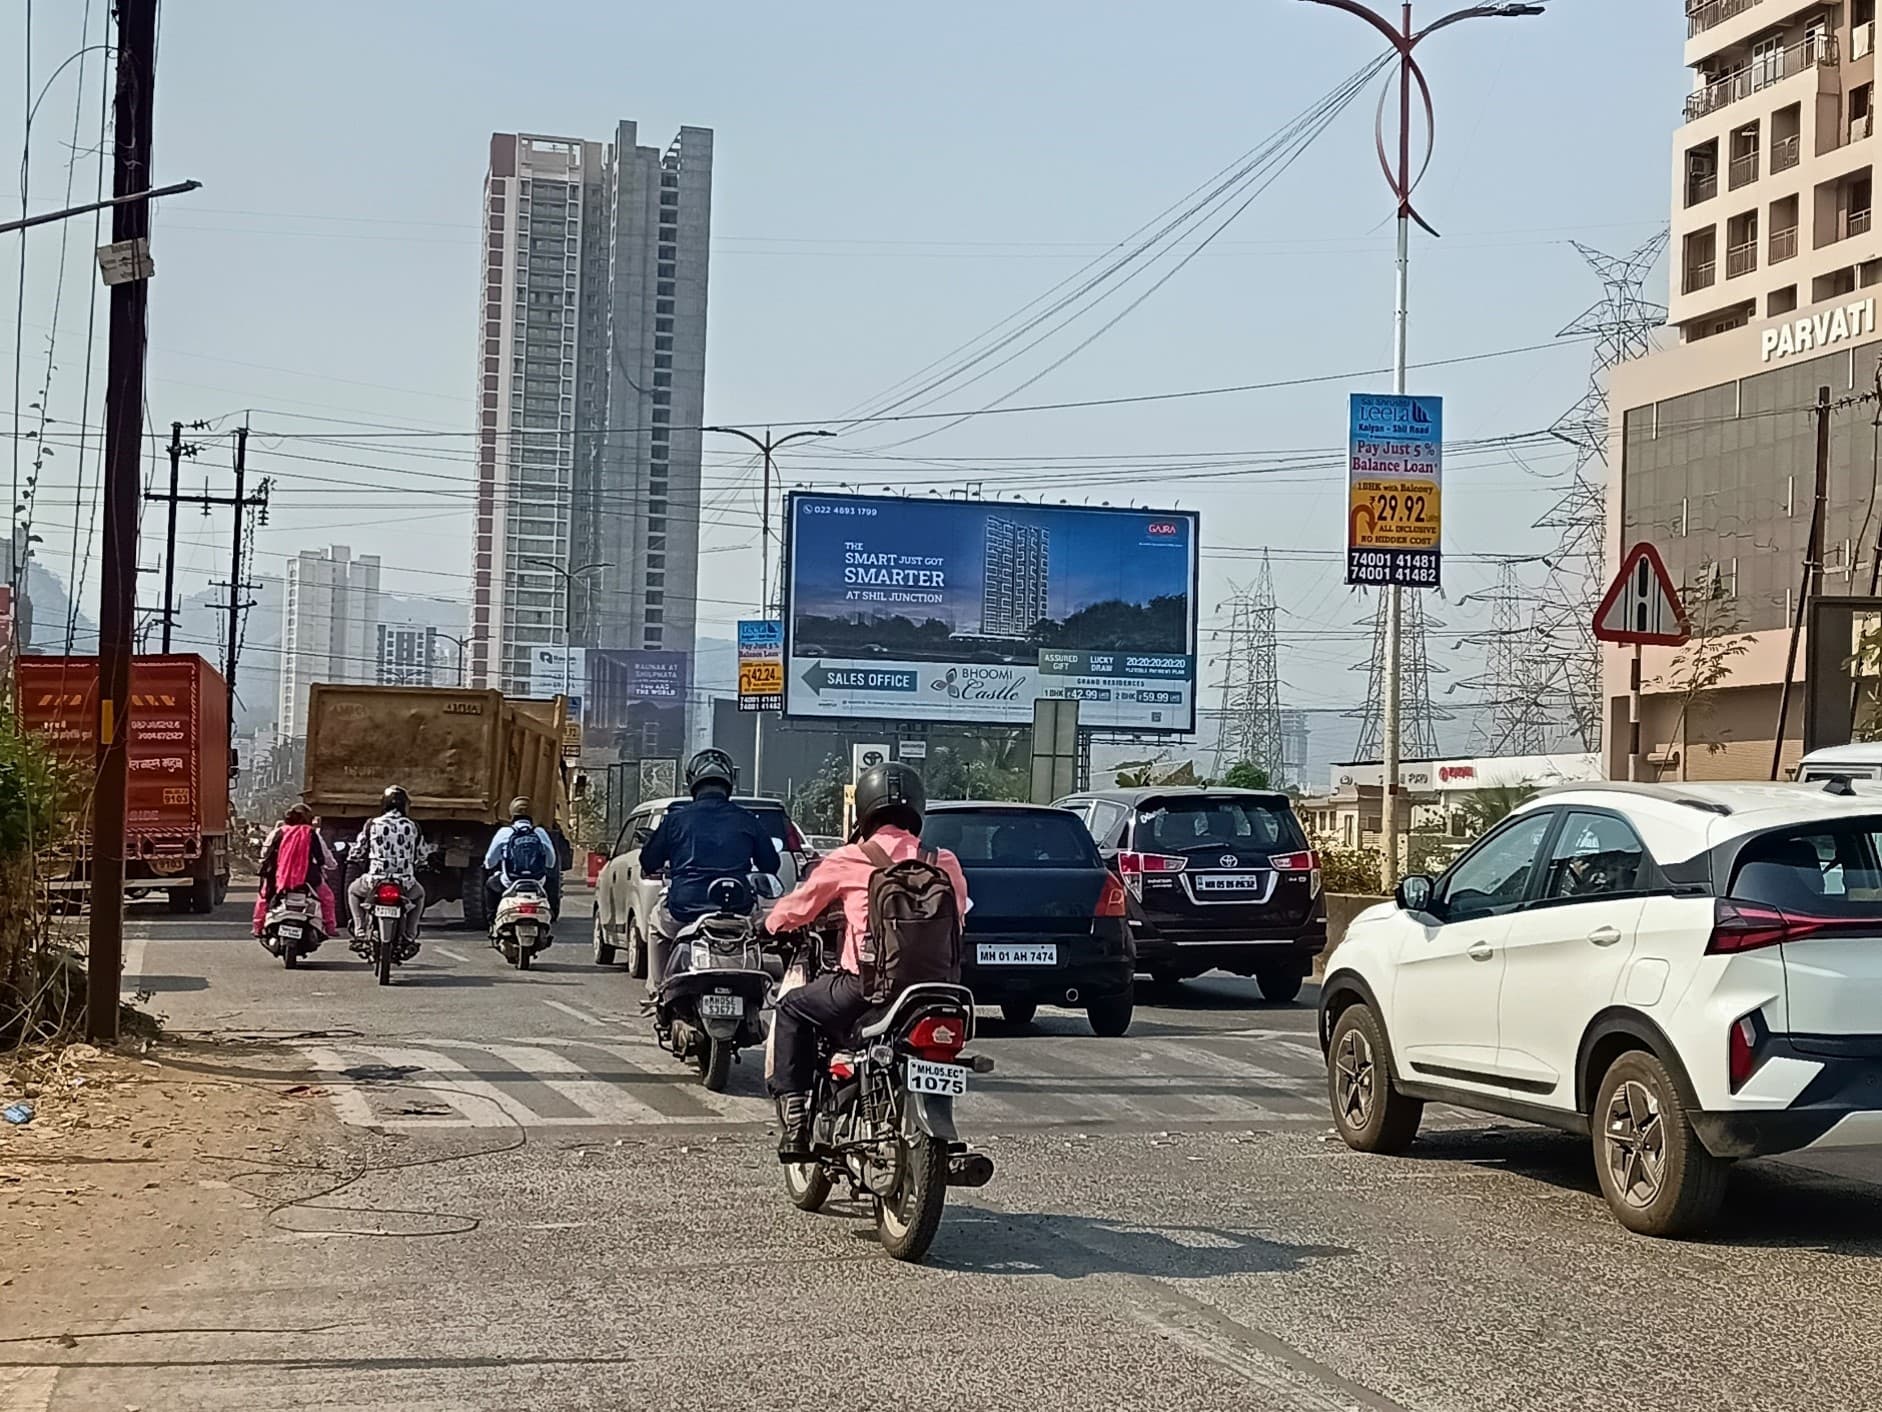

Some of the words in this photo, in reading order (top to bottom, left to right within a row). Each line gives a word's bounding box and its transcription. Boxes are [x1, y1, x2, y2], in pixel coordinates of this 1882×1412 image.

[1761, 298, 1876, 362] PARVATI
[1358, 440, 1380, 456] Pay
[1383, 442, 1410, 456] Just
[1414, 444, 1422, 458] 5
[1352, 457, 1400, 472] Balance
[814, 506, 831, 514] 022
[1379, 525, 1394, 533] ALL
[1396, 526, 1438, 534] INCLUSIVE
[844, 542, 864, 551] THE
[1376, 536, 1408, 544] HIDDEN
[845, 552, 898, 566] SMART
[898, 556, 924, 566] JUST
[924, 557, 944, 566] GOT
[1352, 553, 1392, 566] 74001
[1396, 555, 1436, 568] 41481
[844, 568, 944, 588] SMARTER
[1350, 567, 1390, 580] 74001
[1395, 568, 1436, 582] 41482
[846, 591, 860, 600] AT
[862, 592, 888, 602] SHIL
[889, 593, 943, 604] JUNCTION
[1044, 654, 1078, 664] ASSURED
[1090, 656, 1114, 664] LUCKY
[1052, 662, 1070, 670] GIFT
[1090, 664, 1113, 672] DRAW
[827, 672, 866, 686] SALES
[868, 674, 910, 688] OFFICE
[962, 668, 1013, 680] BHOOMI
[962, 676, 1026, 701] Castle
[980, 951, 996, 961] MH
[998, 951, 1010, 961] 01
[1013, 952, 1028, 962] AH
[1030, 952, 1054, 962] 7474
[912, 1076, 964, 1094] 1075
